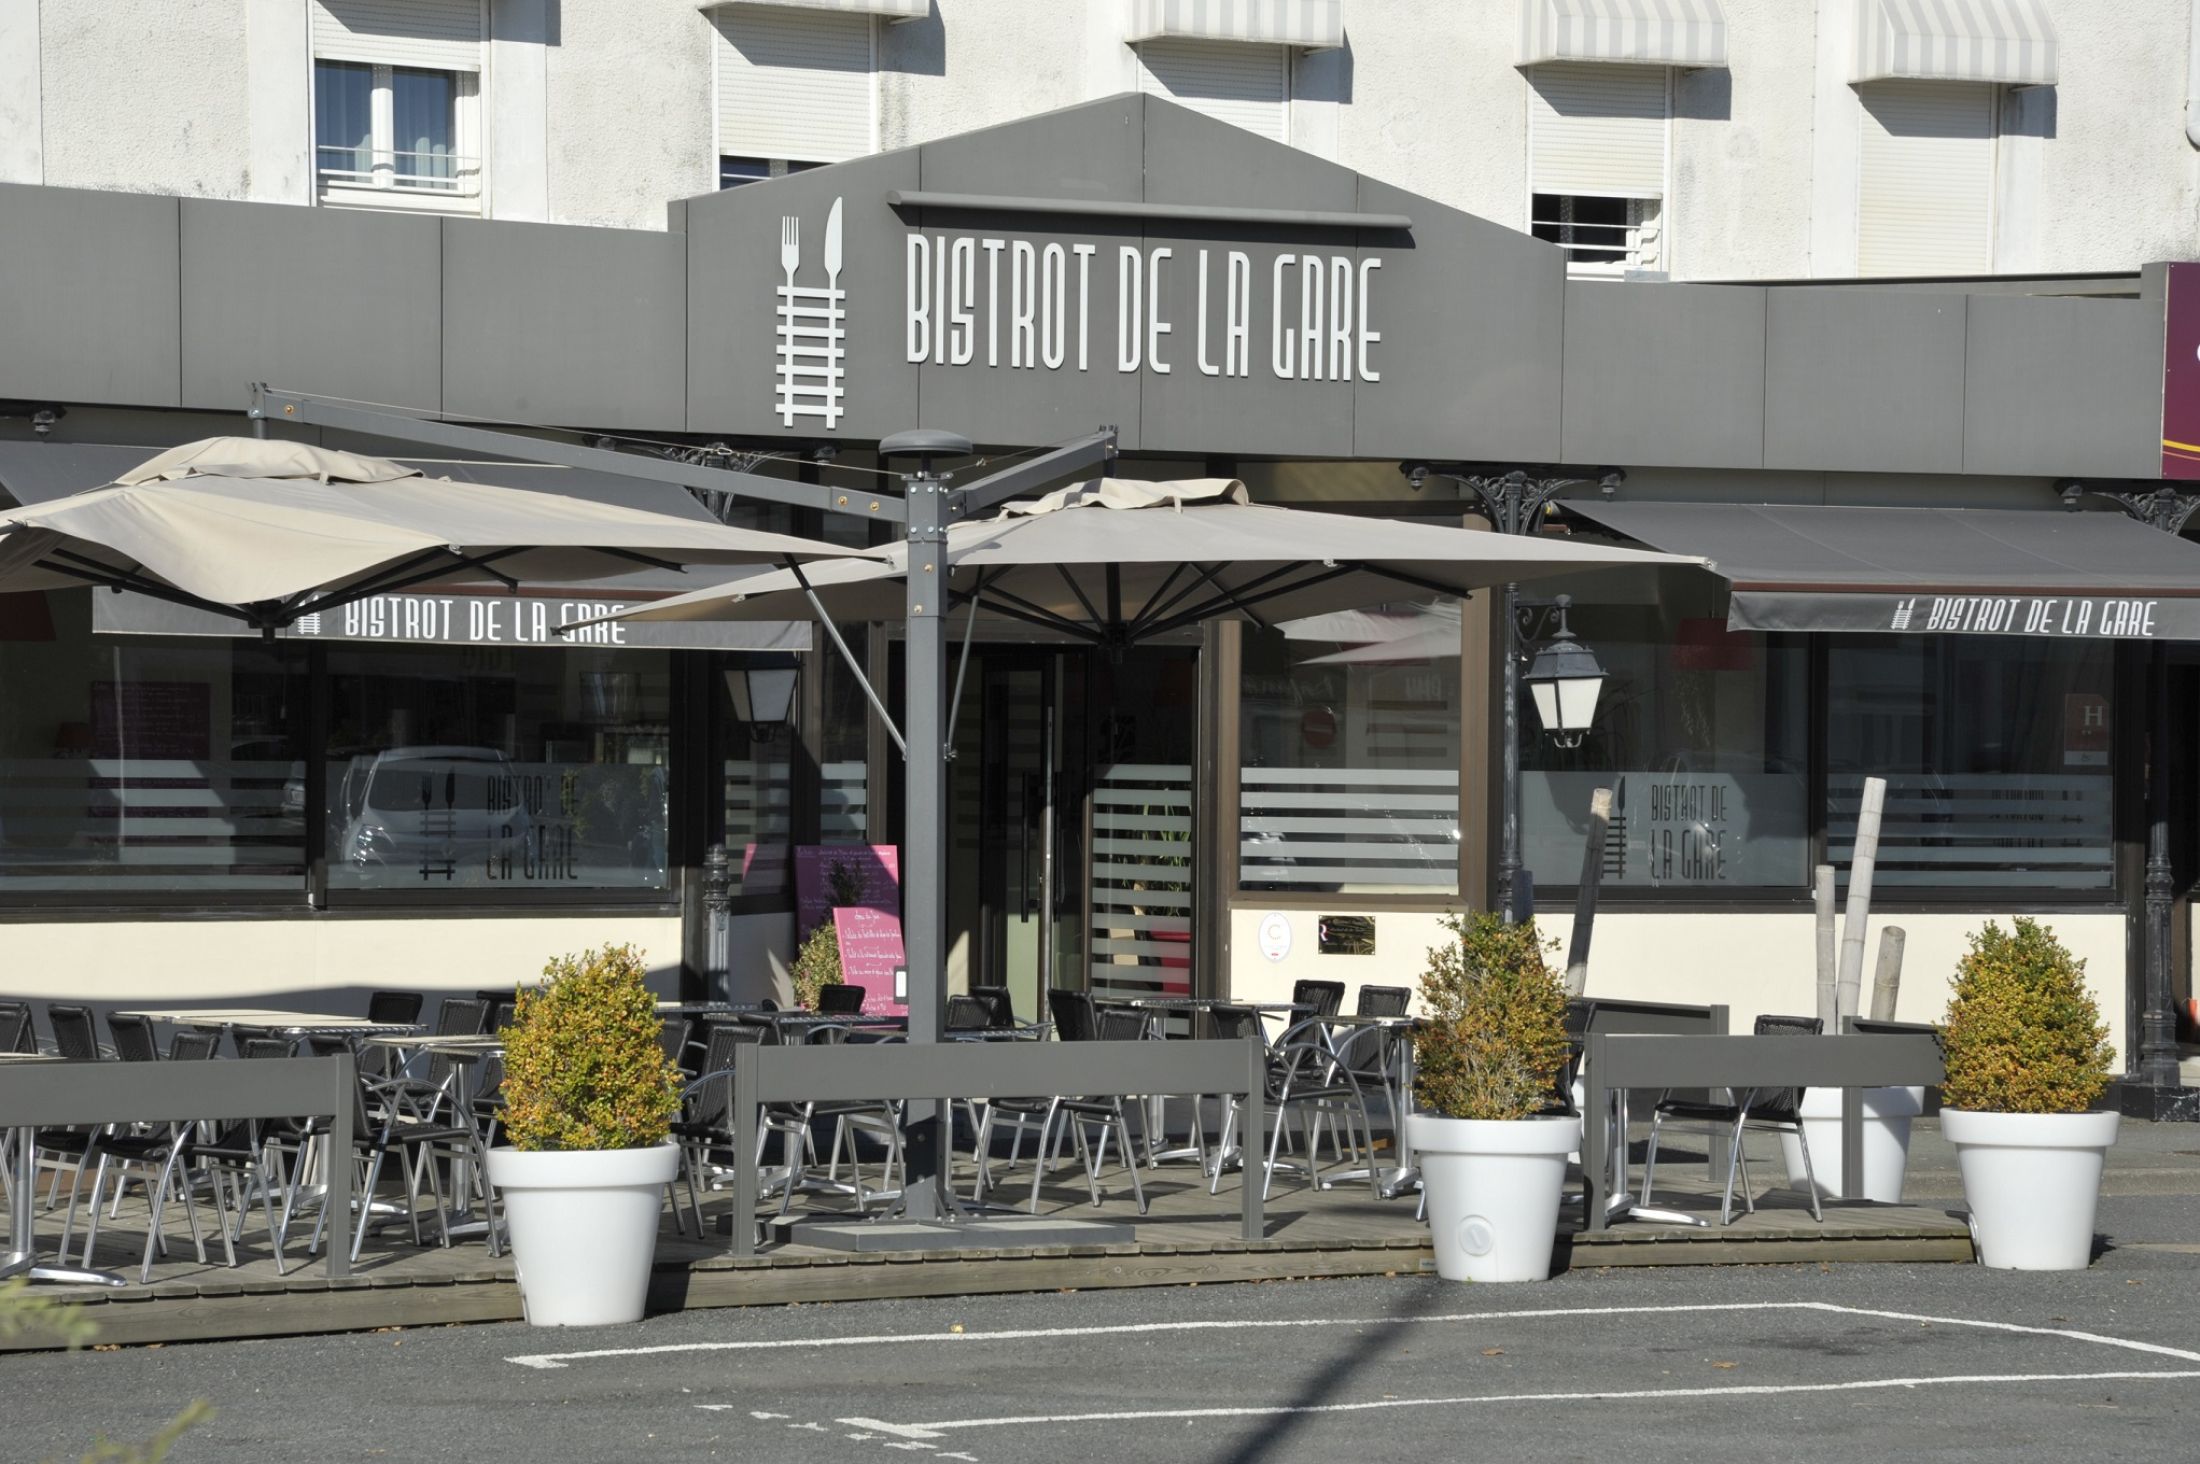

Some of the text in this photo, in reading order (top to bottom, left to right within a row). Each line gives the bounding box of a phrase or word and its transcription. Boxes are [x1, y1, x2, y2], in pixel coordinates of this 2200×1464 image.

[907, 232, 1382, 382] BISTROT DE LA GARE
[345, 597, 626, 644] BISTROT DE LA GARE
[1926, 597, 2158, 636] BISTROT DE LA GARE
[2084, 705, 2104, 726] H
[1651, 784, 1728, 821] BISTROT DE
[1651, 829, 1727, 880] LA GARE
